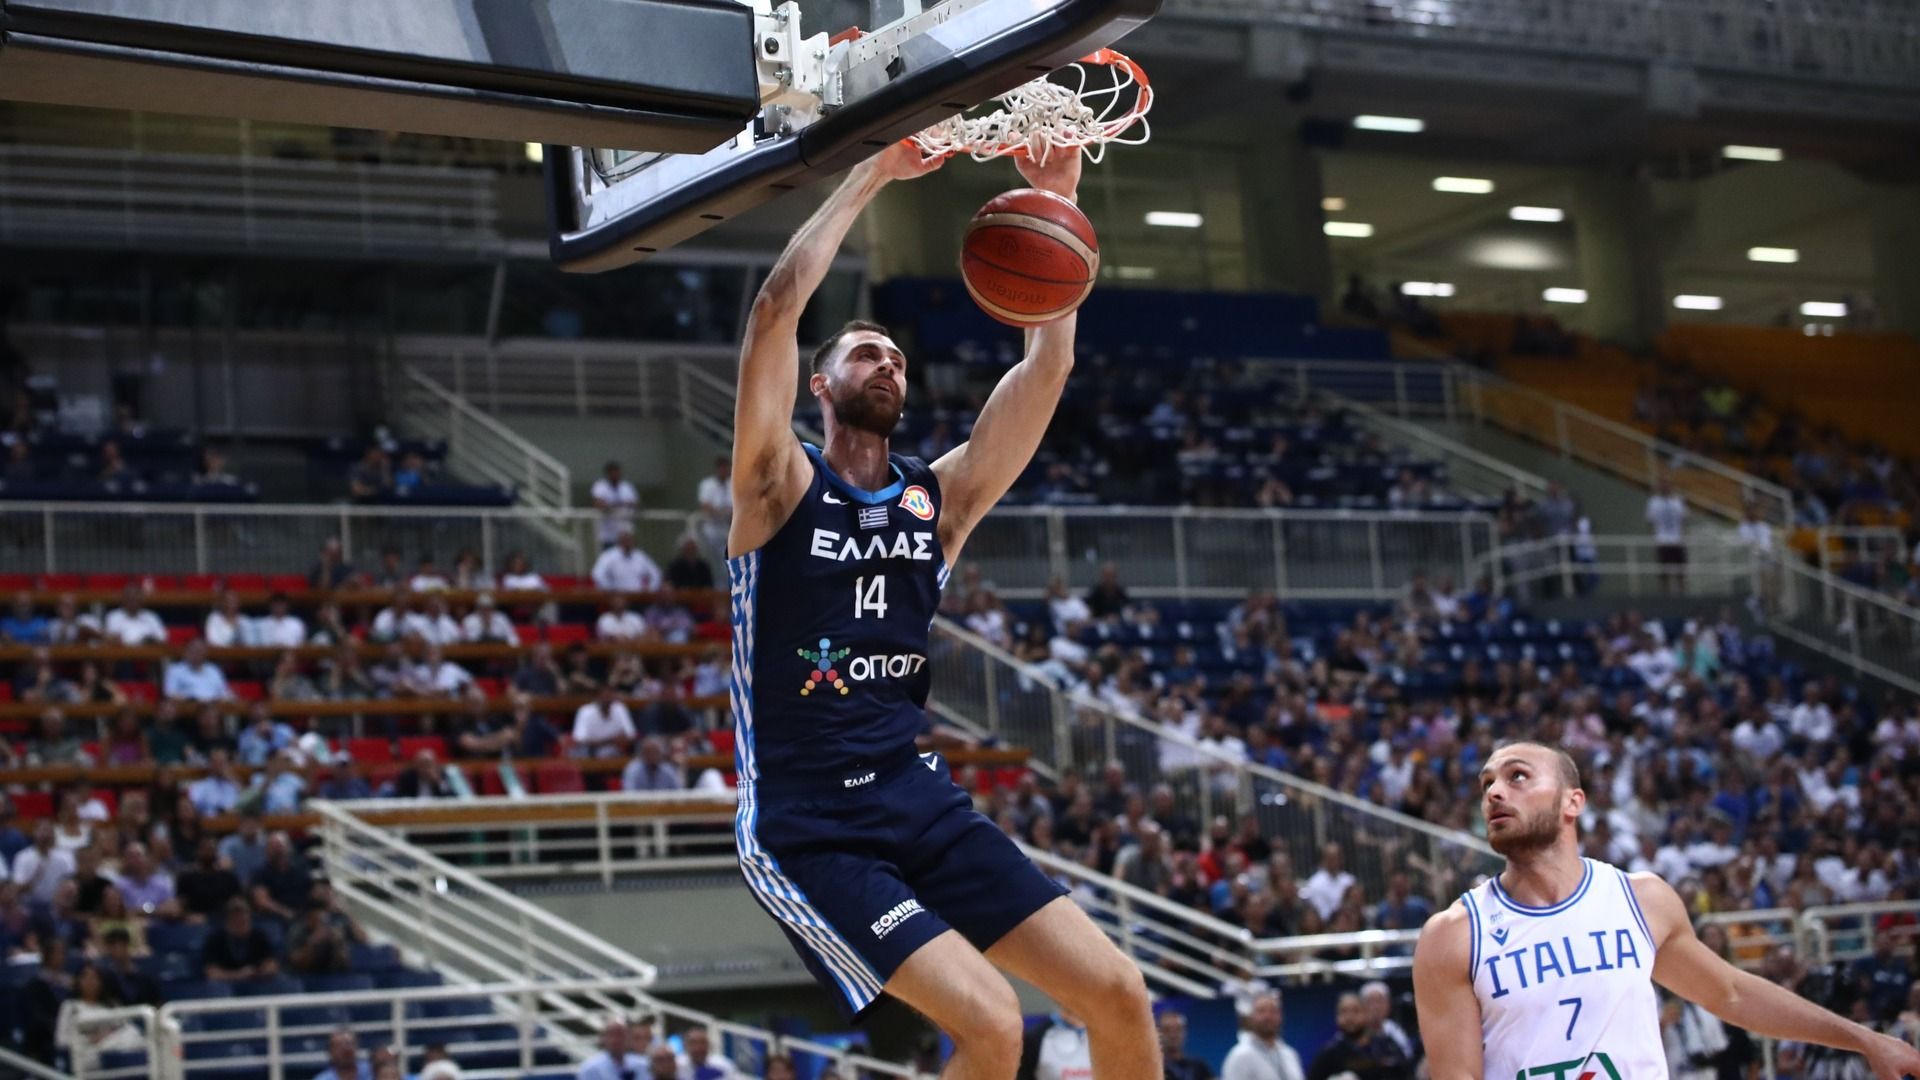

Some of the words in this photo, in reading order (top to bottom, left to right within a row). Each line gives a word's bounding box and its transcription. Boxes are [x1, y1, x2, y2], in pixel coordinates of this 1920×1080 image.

[986, 279, 1048, 304] molten
[811, 528, 933, 561] ΕΛΛΑΣ
[855, 575, 888, 619] 14
[844, 772, 876, 788] ΕΛΛΑΣ
[1484, 928, 1641, 999] ITALIA
[1559, 997, 1582, 1041] 7
